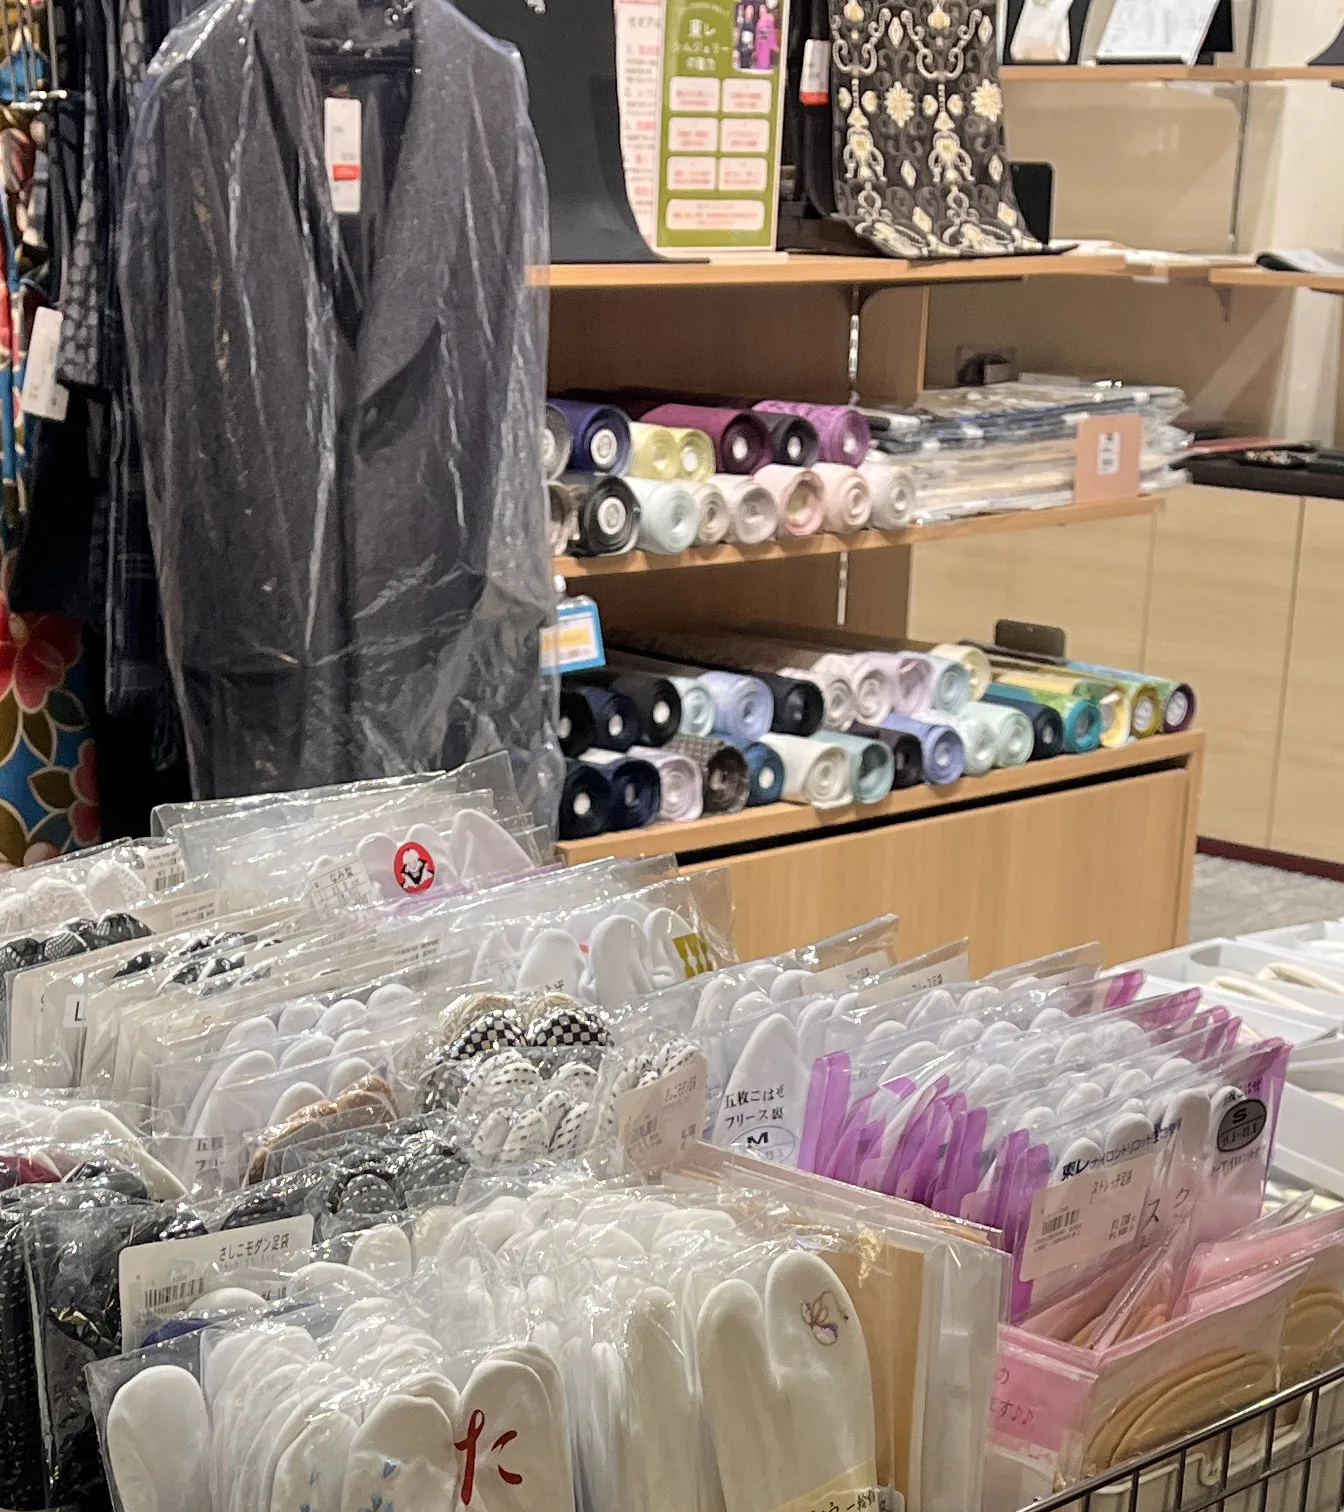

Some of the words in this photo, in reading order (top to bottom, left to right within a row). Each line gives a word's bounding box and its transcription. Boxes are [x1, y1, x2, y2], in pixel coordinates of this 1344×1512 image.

[74, 1000, 86, 1022] L
[724, 1083, 785, 1109] 五枚こはぜ
[1232, 1107, 1248, 1124] S
[746, 1131, 769, 1148] M
[219, 1232, 290, 1262] さしこモダン足袋
